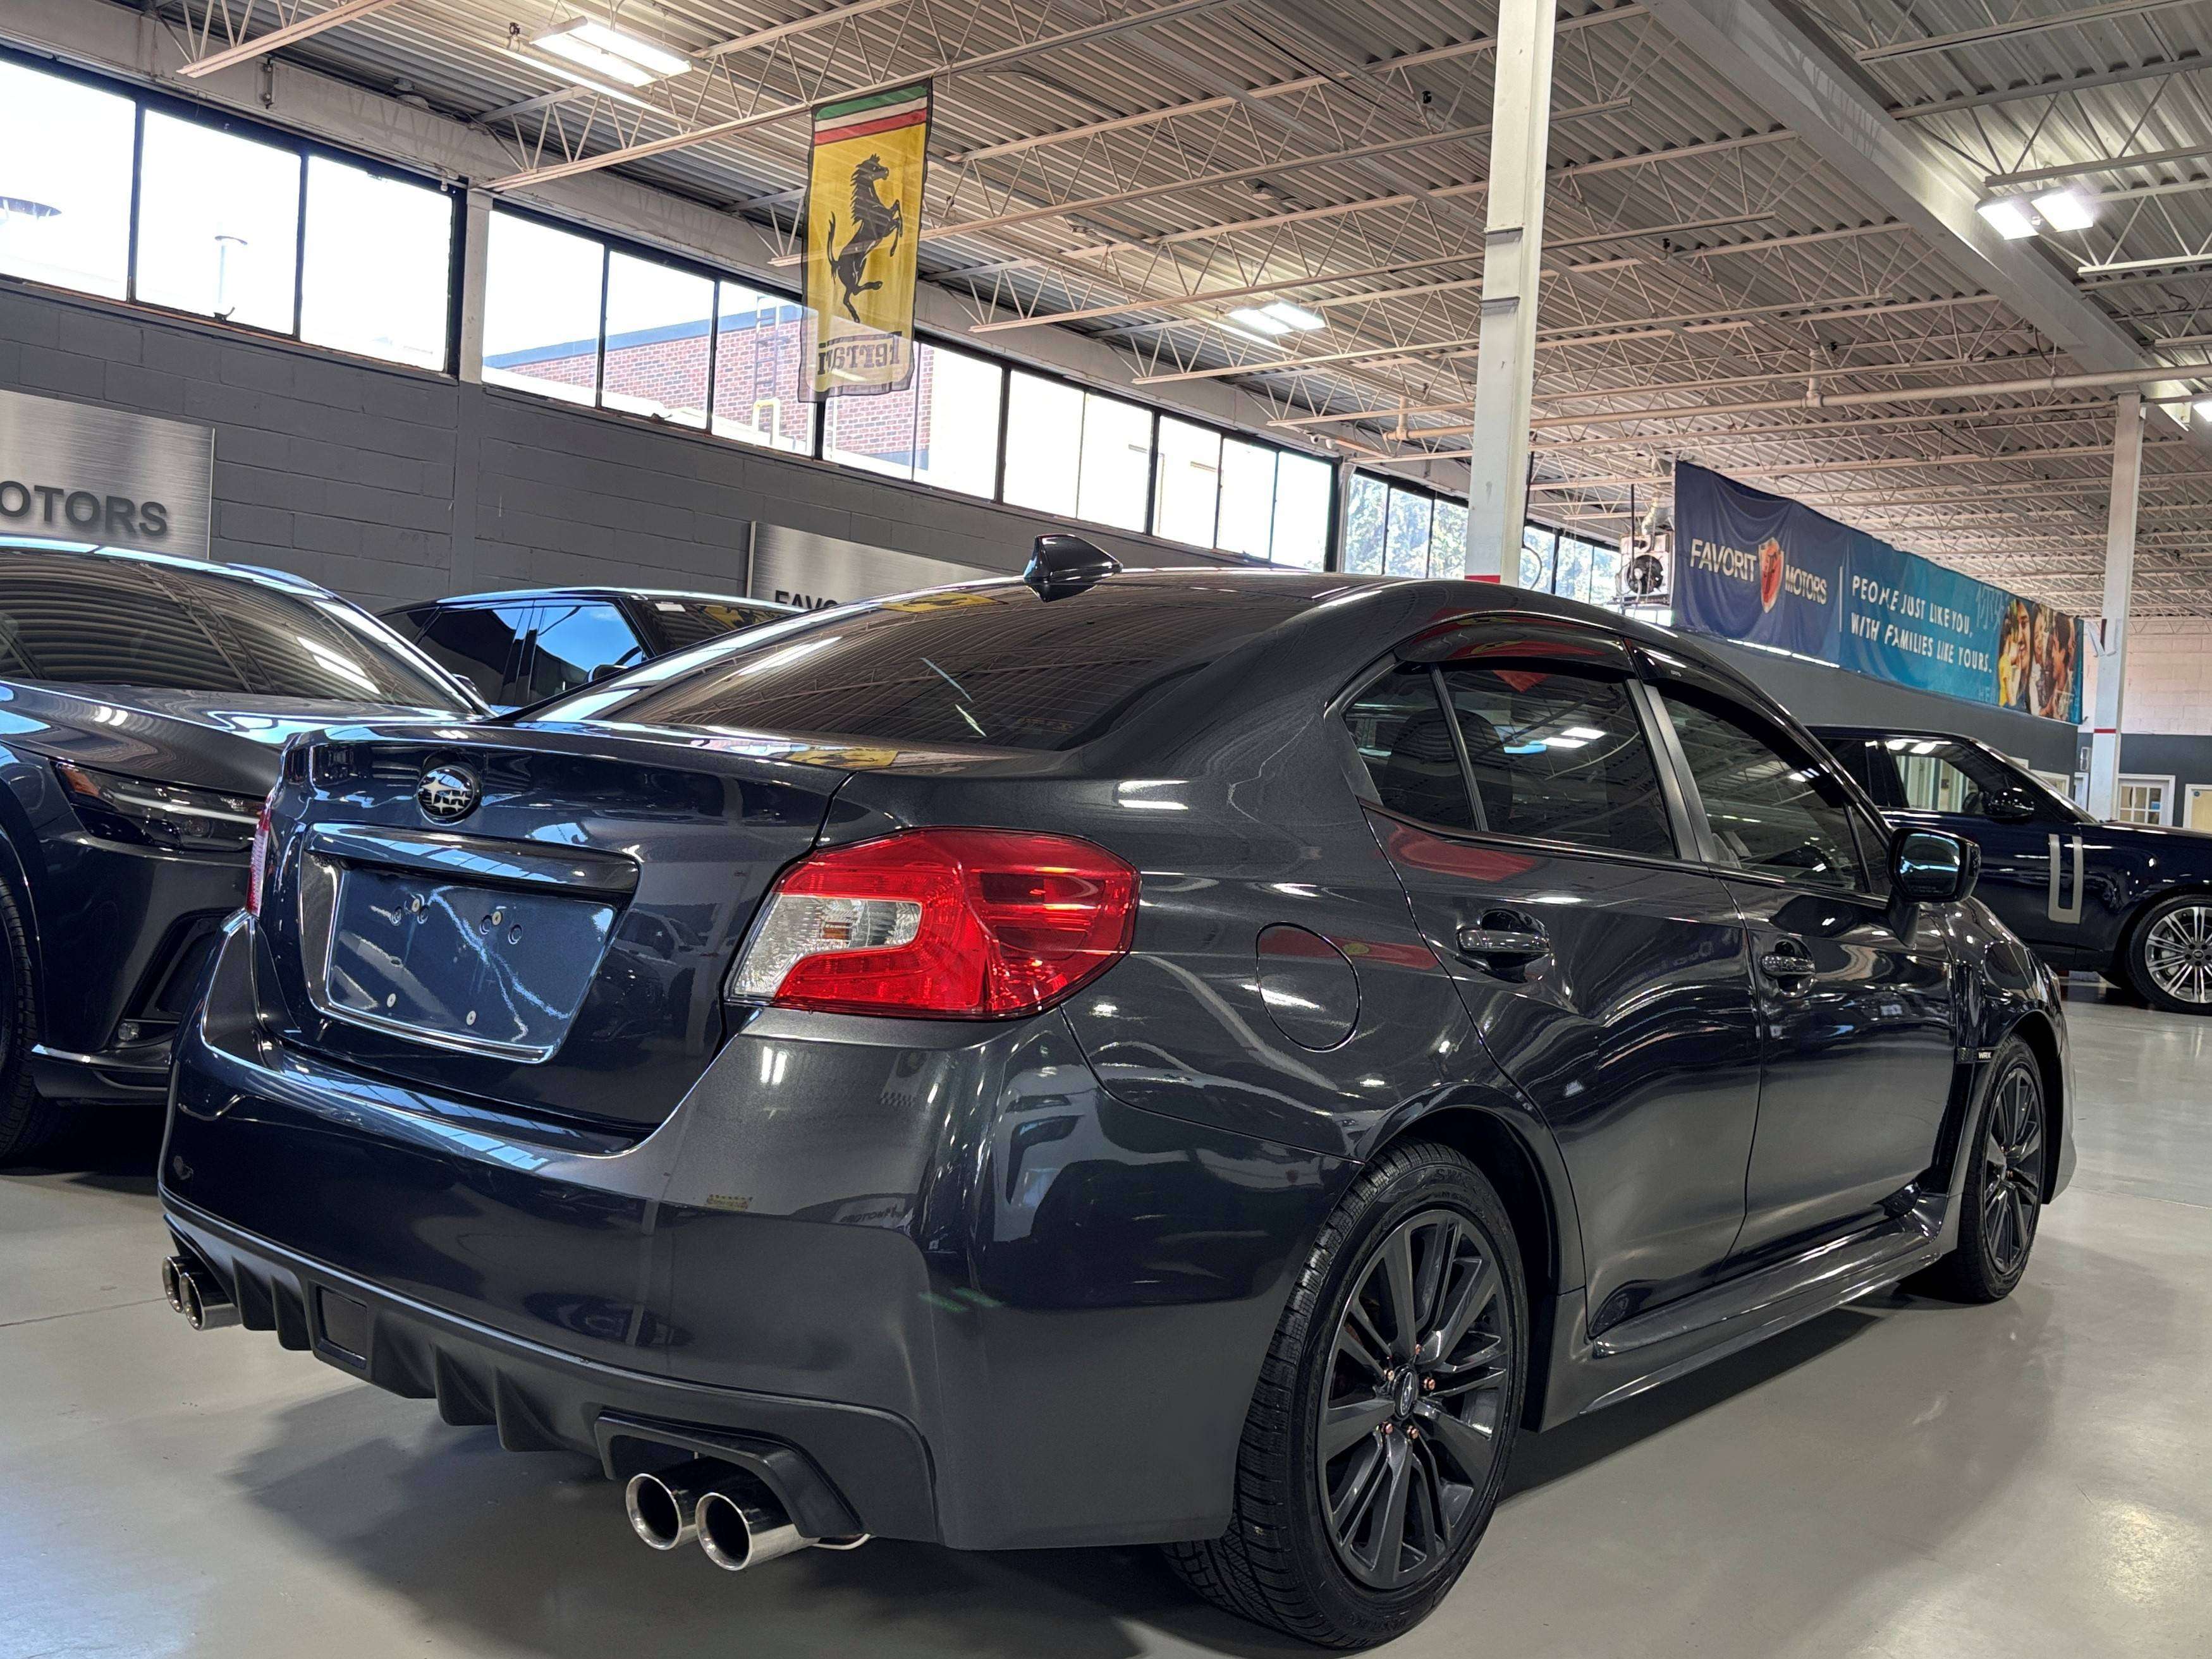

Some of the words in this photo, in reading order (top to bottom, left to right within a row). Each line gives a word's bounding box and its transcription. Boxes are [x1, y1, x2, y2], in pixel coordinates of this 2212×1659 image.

[1689, 538, 1757, 582] FAVORIT
[1785, 564, 1827, 605] MOTORS
[1900, 594, 1926, 619] JUST
[1929, 602, 1950, 628] LIKE
[1851, 612, 1881, 642] WITH
[1884, 624, 1933, 657] FAMILIES
[1936, 640, 1954, 664] LIKE
